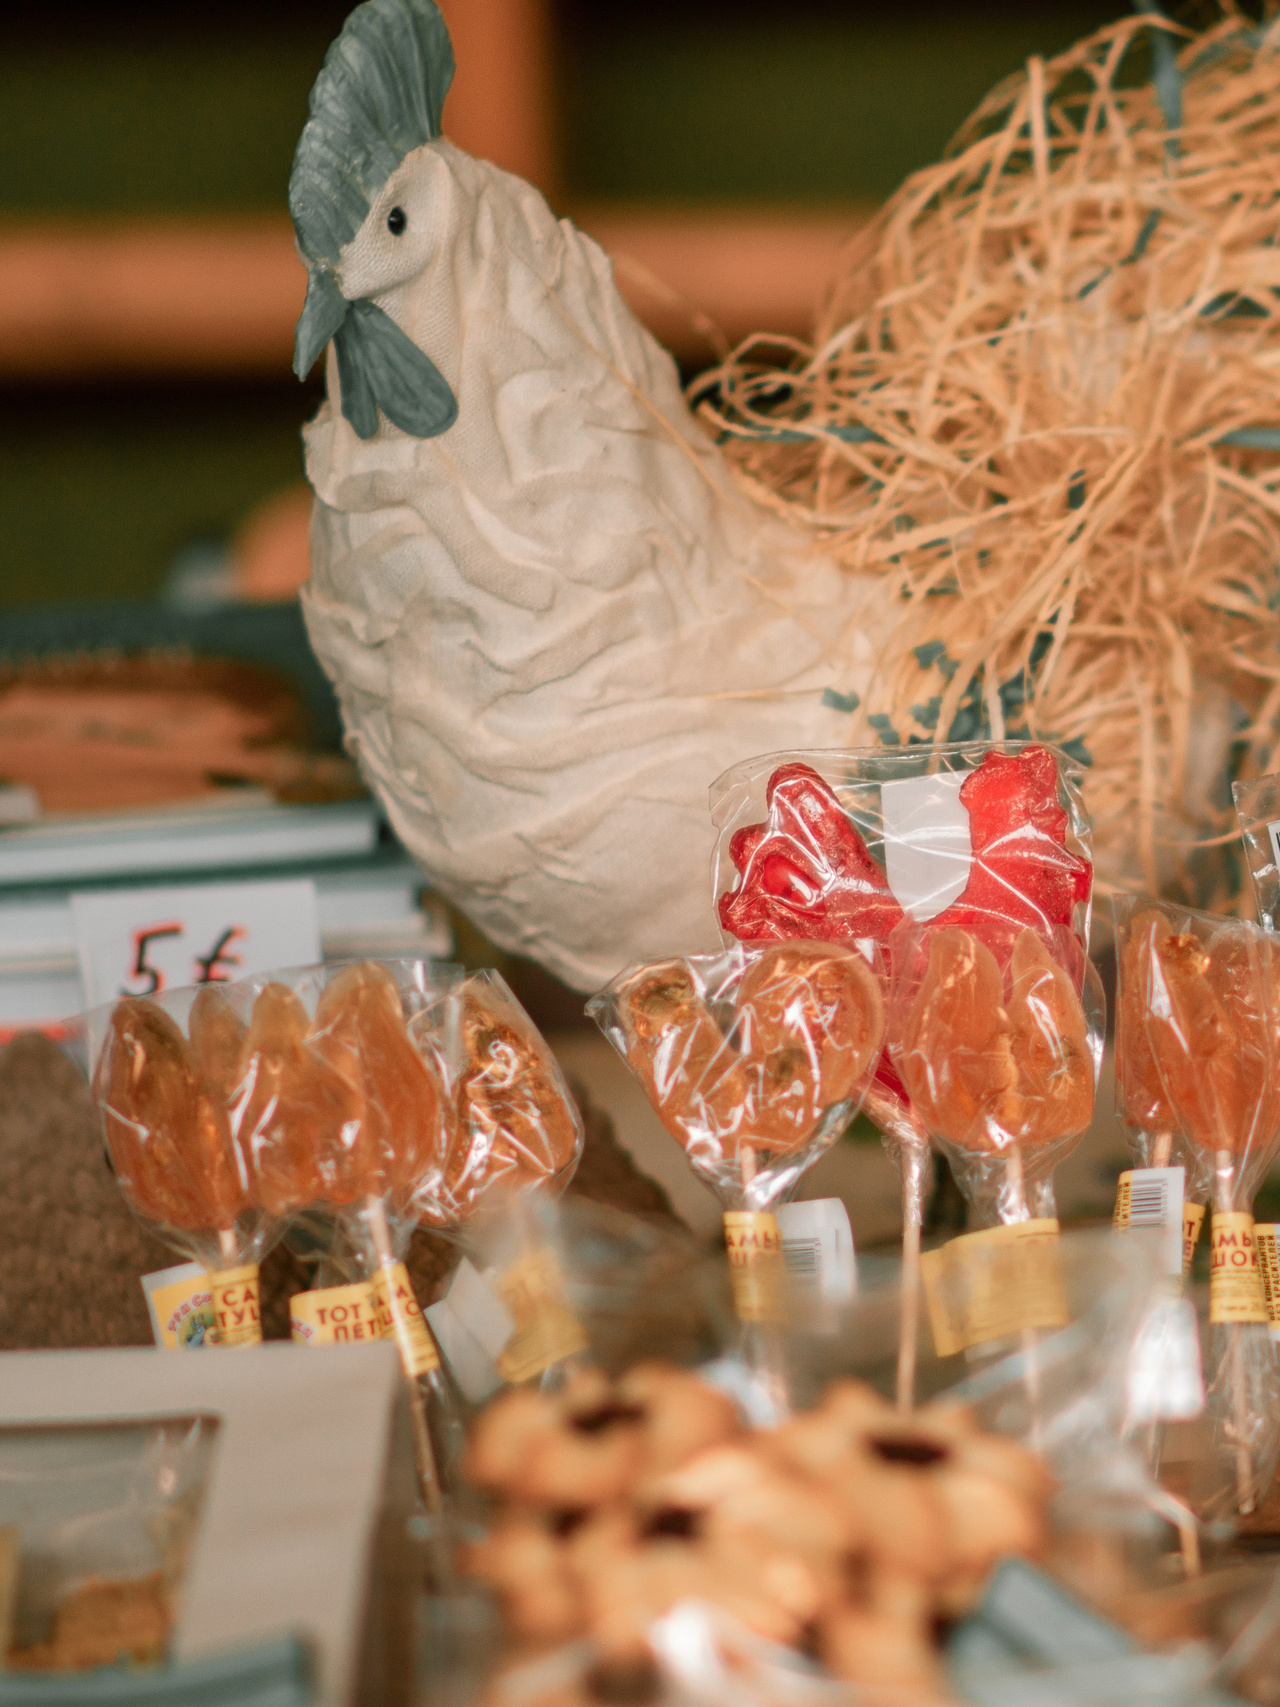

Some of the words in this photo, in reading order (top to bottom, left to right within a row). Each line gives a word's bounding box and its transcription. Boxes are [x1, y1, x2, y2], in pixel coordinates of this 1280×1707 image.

[121, 922, 184, 998] 5
[1257, 1235, 1273, 1302] КОНСЕРВАНТОВ
[316, 1303, 361, 1325] ТОТ
